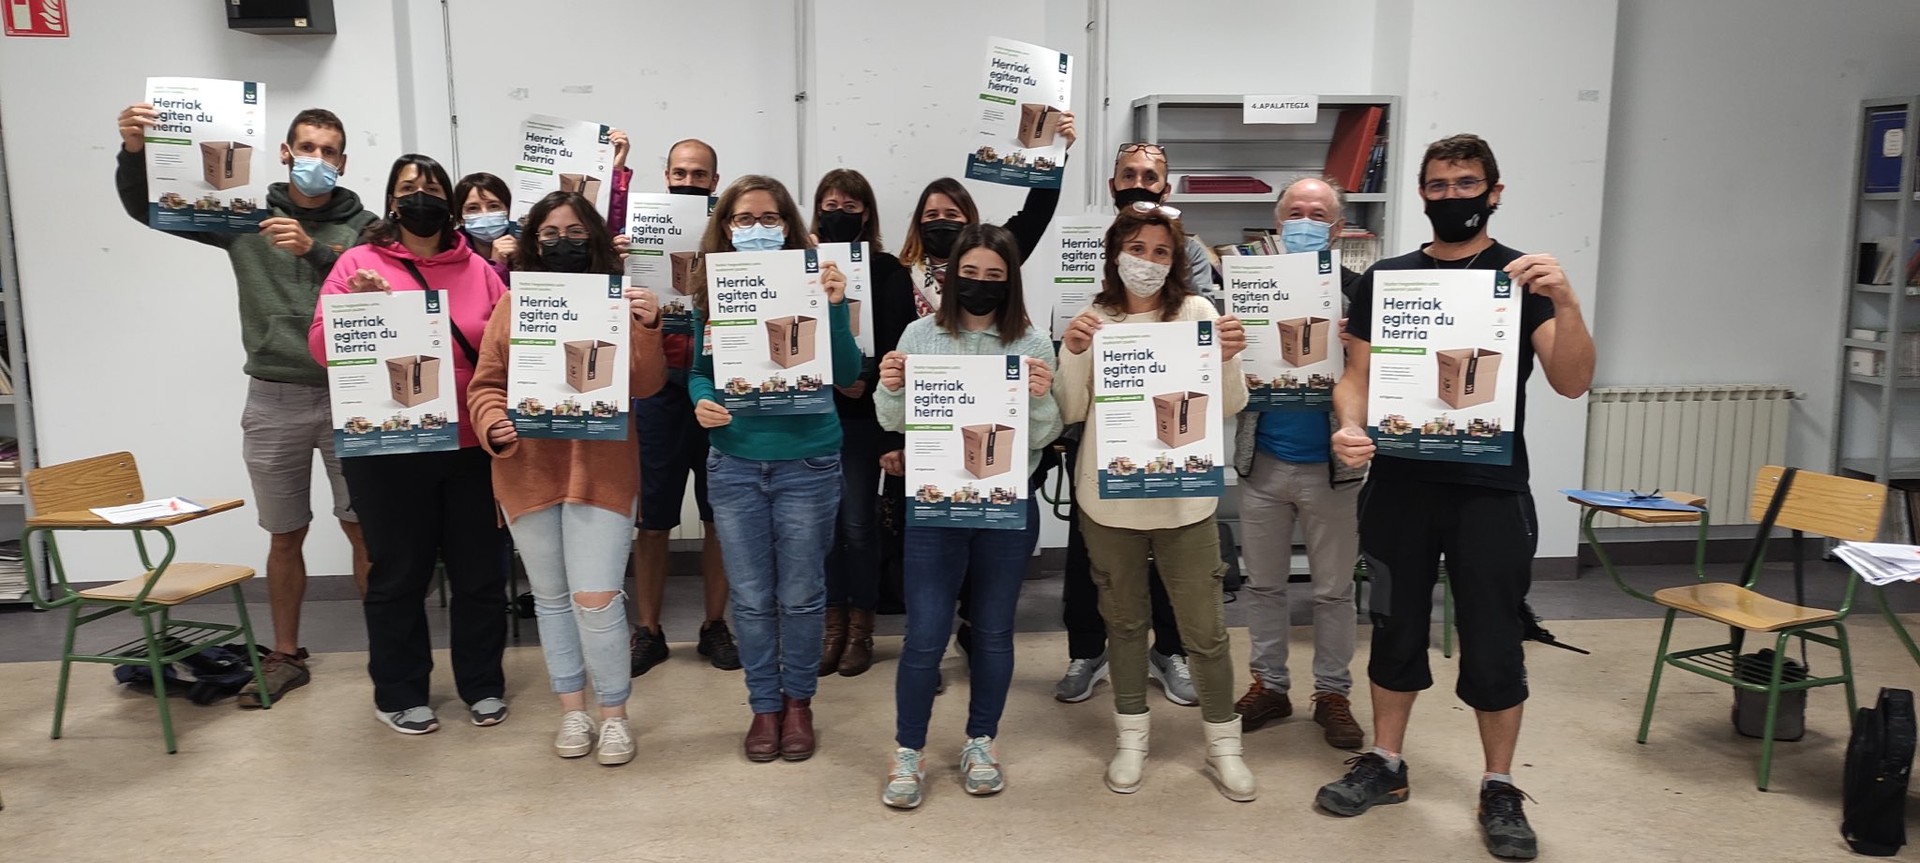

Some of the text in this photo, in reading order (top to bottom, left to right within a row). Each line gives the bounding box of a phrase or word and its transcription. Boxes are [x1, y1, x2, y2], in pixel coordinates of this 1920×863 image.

[992, 58, 1030, 74] Herriak
[990, 71, 1036, 86] egiten du
[988, 80, 1018, 94] herria
[153, 98, 202, 110] Herriak
[197, 112, 213, 122] du
[526, 132, 565, 146] Herriak
[525, 144, 572, 157] egiten du
[524, 153, 554, 164] herria
[633, 213, 672, 224] Herriak
[632, 225, 681, 235] egiten du
[631, 235, 663, 244] herria
[1062, 238, 1105, 248] Herriak
[1062, 250, 1096, 262] egiten
[1062, 262, 1095, 272] herria
[717, 277, 765, 288] Herriak
[1231, 279, 1278, 289] Herriak
[520, 296, 567, 307] Herriak
[718, 289, 776, 302] egiten du
[1232, 291, 1289, 303] egiten du
[718, 303, 756, 313] herria
[1232, 303, 1269, 313] herria
[1383, 298, 1442, 310] Herriak
[520, 309, 578, 321] egiten du
[1383, 313, 1454, 328] egiten du
[333, 316, 384, 328] Herriak
[519, 322, 556, 333] herria
[334, 329, 397, 343] egiten du
[1382, 327, 1427, 339] herria
[335, 342, 375, 353] herria
[1103, 349, 1154, 362] Herriak
[1103, 362, 1166, 377] egiten du
[915, 380, 963, 391] Herriak
[1104, 376, 1144, 388] herria
[915, 393, 975, 406] egiten du
[915, 406, 953, 417] herria
